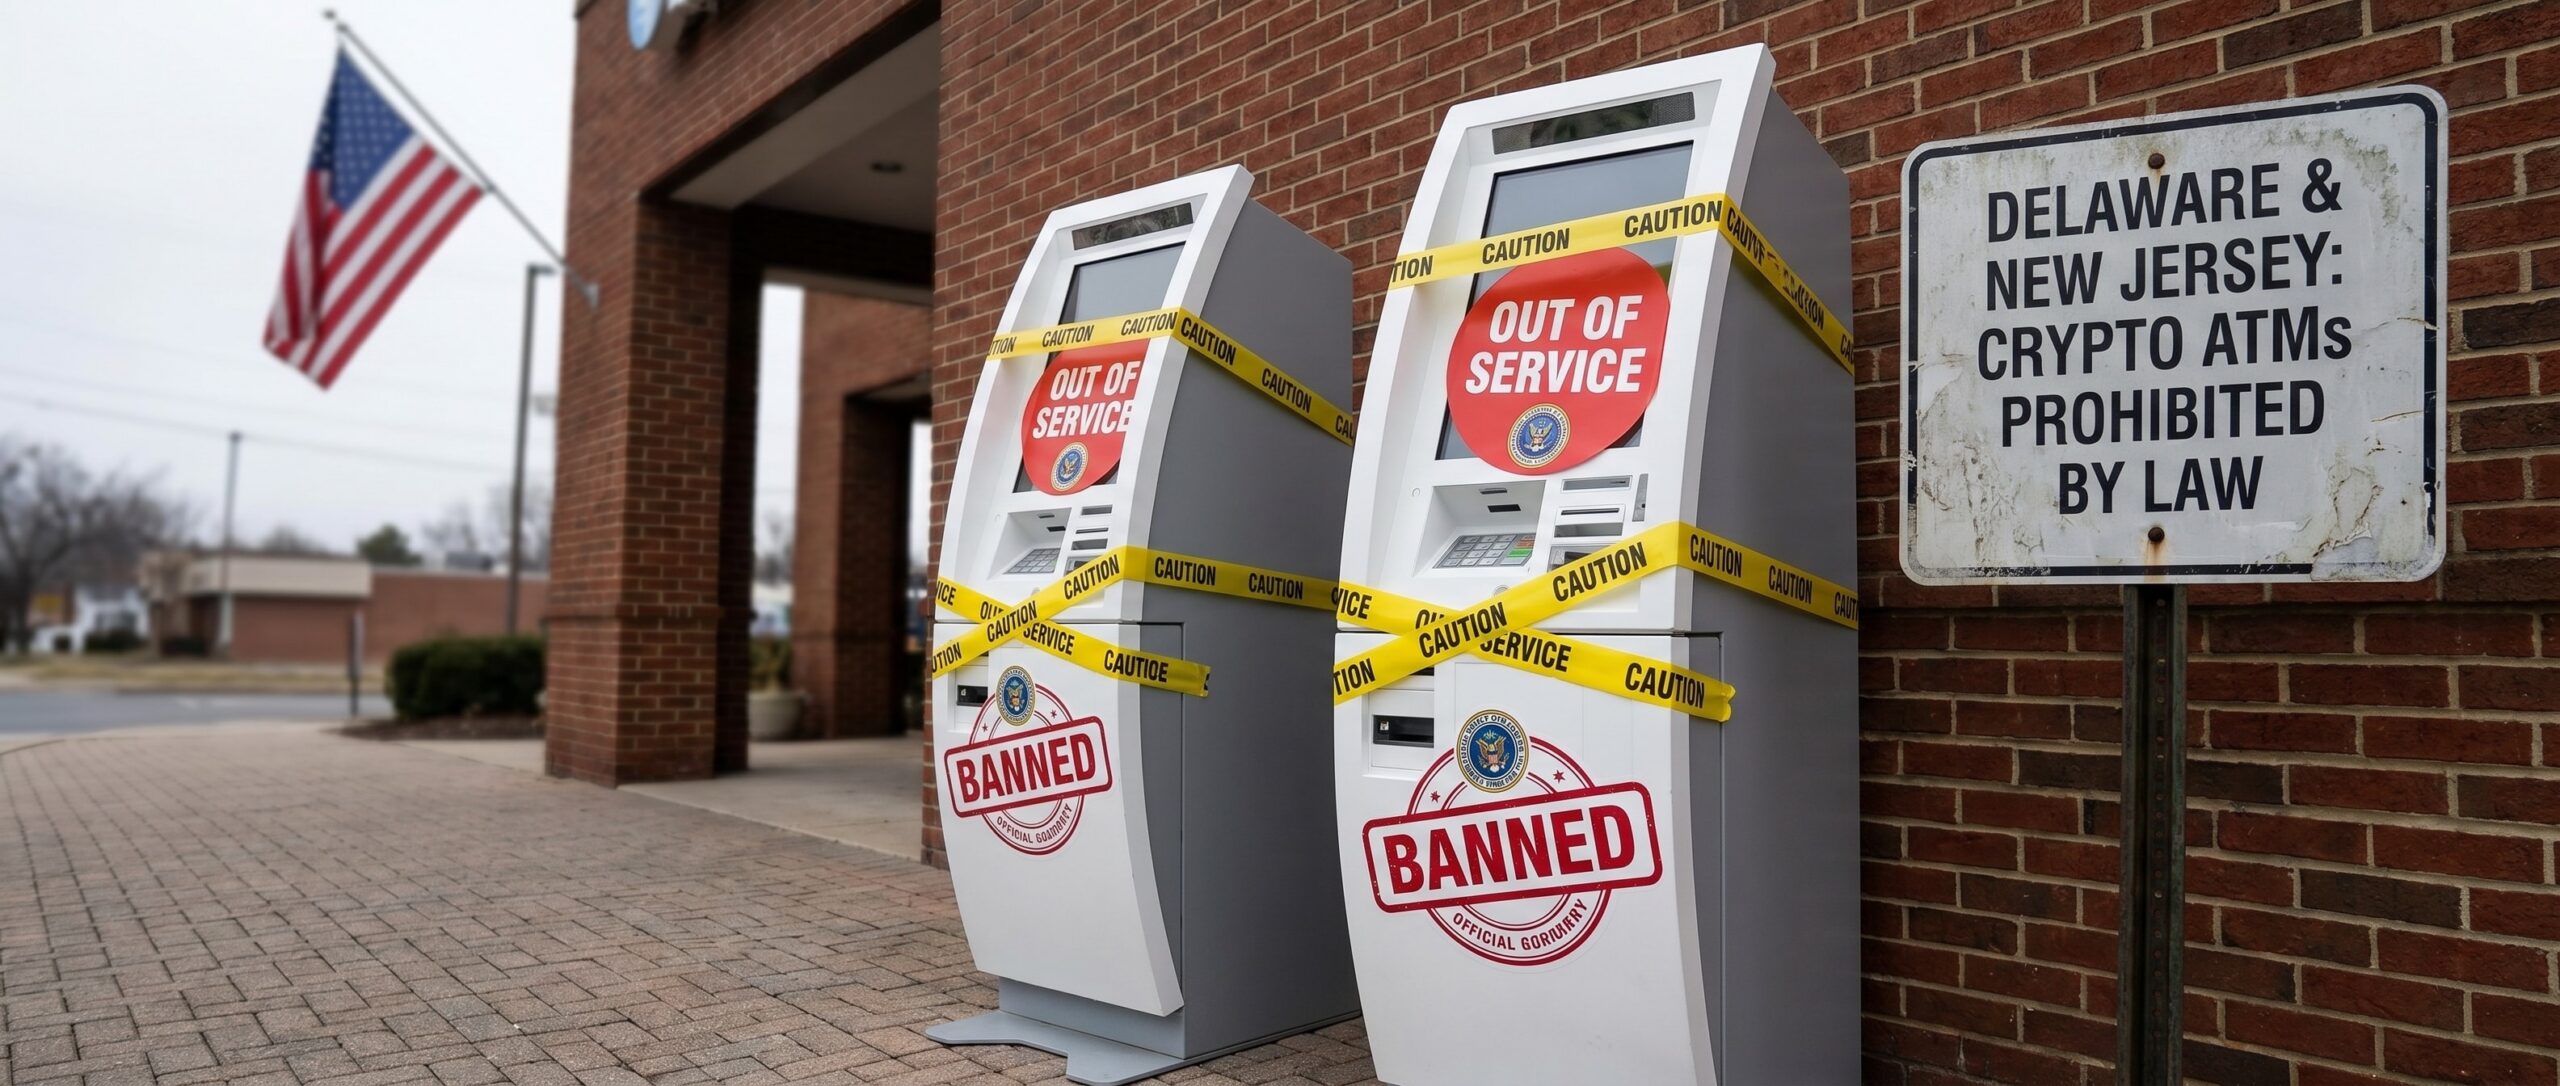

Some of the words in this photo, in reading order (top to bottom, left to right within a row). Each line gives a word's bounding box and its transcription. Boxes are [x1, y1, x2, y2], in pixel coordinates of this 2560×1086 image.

[1482, 228, 1570, 265] CAUTION
[1624, 200, 1722, 238] CAUTION
[1988, 162, 2280, 243] DELAWARE
[2302, 157, 2343, 214] &
[1986, 251, 2103, 311] NEW
[2120, 231, 2343, 301] JERSEY:
[988, 336, 1017, 357] TION
[1042, 324, 1095, 348] CAUTION
[1120, 311, 1177, 336] CAUTION
[1488, 299, 1576, 344] OUT
[1582, 295, 1643, 340] OF
[1977, 315, 2183, 381] CRYPTO
[2202, 305, 2352, 367] ATMs
[1049, 364, 1102, 401] OUT
[1103, 361, 1141, 397] OF
[1180, 317, 1236, 366] CAUTION
[1261, 367, 1312, 413] CAUTION
[1465, 347, 1647, 395] SERVICE
[1032, 398, 1135, 439] SERVICE
[2001, 379, 2325, 448] PROHIBITED
[2058, 461, 2126, 515] BY
[2144, 455, 2264, 513] LAW
[987, 600, 1037, 643] CAUTION
[1064, 554, 1120, 600] CAUTION
[1154, 556, 1216, 586] CAUTION
[1249, 572, 1304, 600] CAUTION
[1418, 601, 1508, 658] CAUTION
[1552, 541, 1647, 602] CAUTION
[1690, 534, 1742, 578] CAUTION
[1768, 565, 1813, 605] CAUTION
[1480, 631, 1571, 673] SERVICE
[1624, 662, 1705, 708] CAUTION
[956, 733, 1097, 803] BANNED
[1383, 805, 1635, 895] BANNED
[1453, 912, 1516, 951] OFFICIAL
